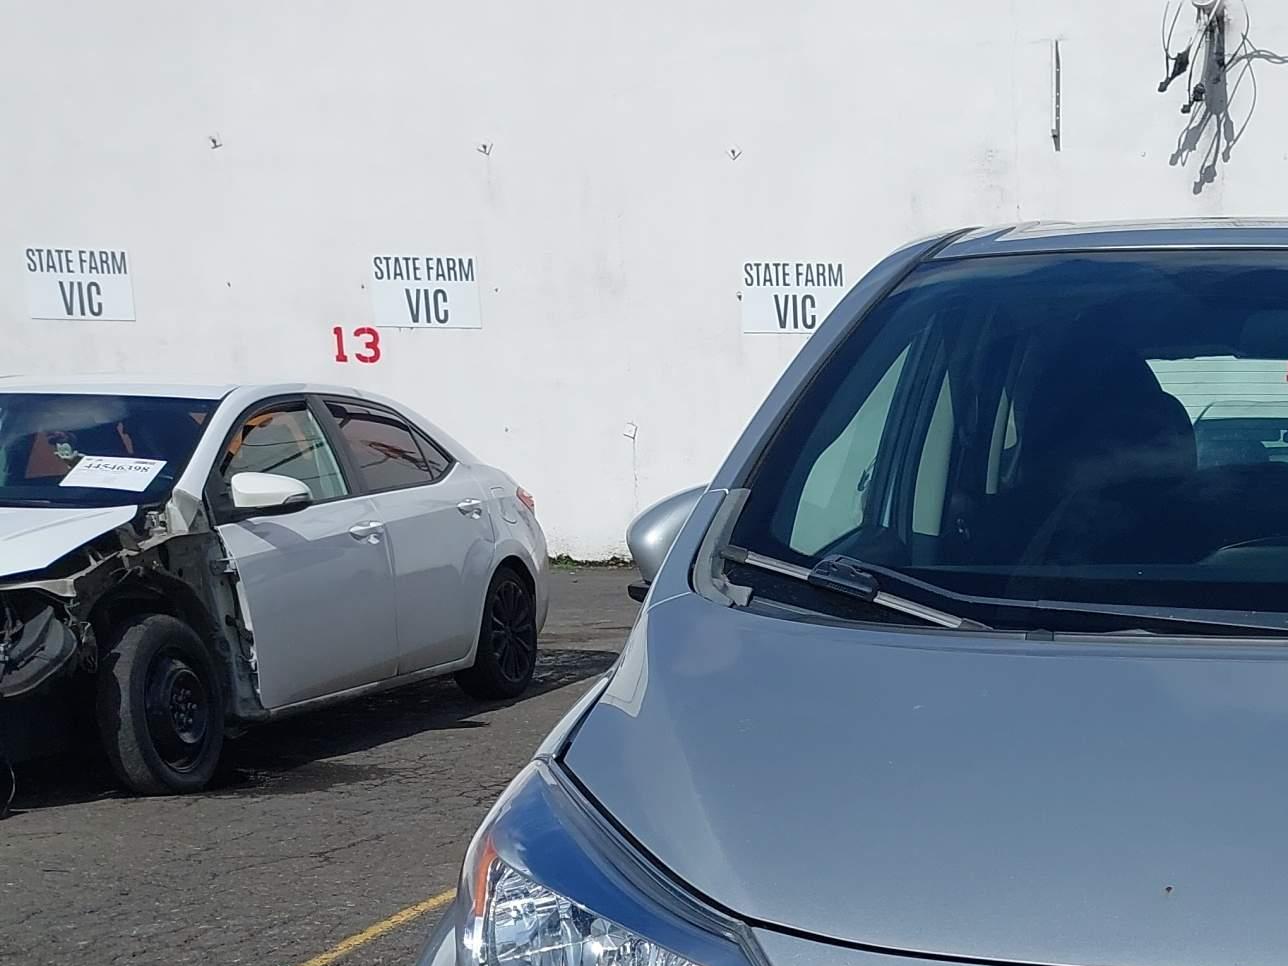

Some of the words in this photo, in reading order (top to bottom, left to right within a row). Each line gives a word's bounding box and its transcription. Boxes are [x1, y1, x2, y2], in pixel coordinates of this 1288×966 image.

[26, 248, 75, 273] STATE
[79, 250, 127, 274] FARM
[373, 256, 421, 280] STATE
[426, 257, 474, 281] FARM
[744, 262, 790, 287] STATE
[795, 263, 843, 287] FARM
[59, 280, 102, 316] VIC
[405, 288, 448, 323] VIC
[773, 294, 816, 329] VIC
[333, 326, 380, 363] 13
